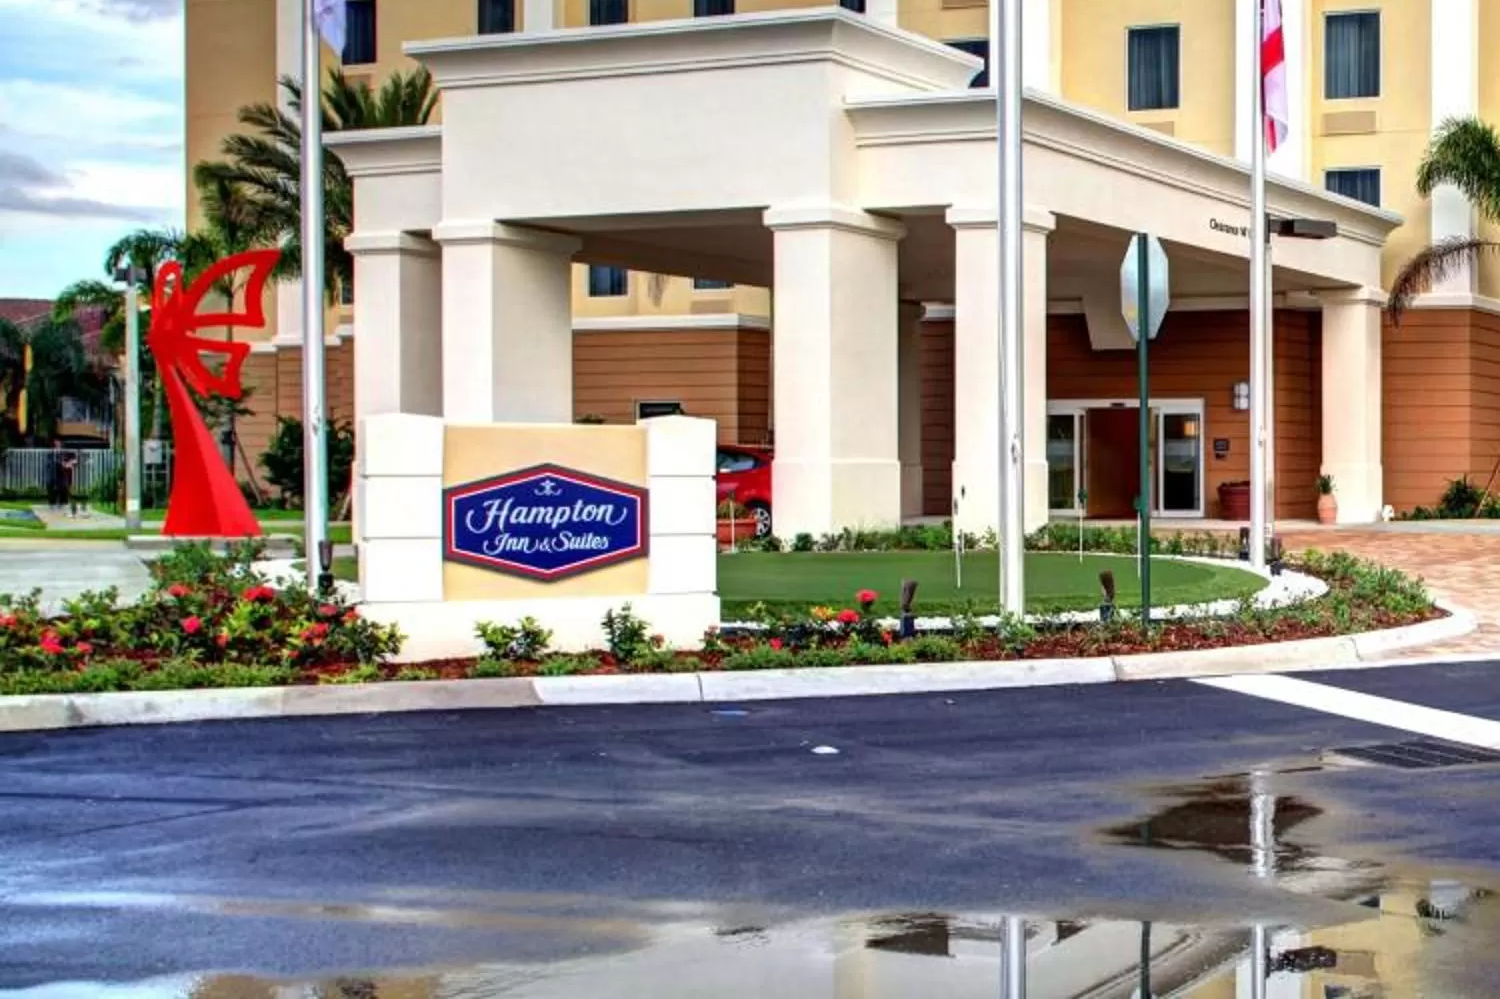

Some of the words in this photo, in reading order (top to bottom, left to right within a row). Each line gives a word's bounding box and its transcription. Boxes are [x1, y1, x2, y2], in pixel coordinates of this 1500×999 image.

[465, 497, 628, 534] Hampton
[483, 532, 539, 555] Inn
[539, 536, 551, 551] &
[551, 531, 609, 552] Suites
